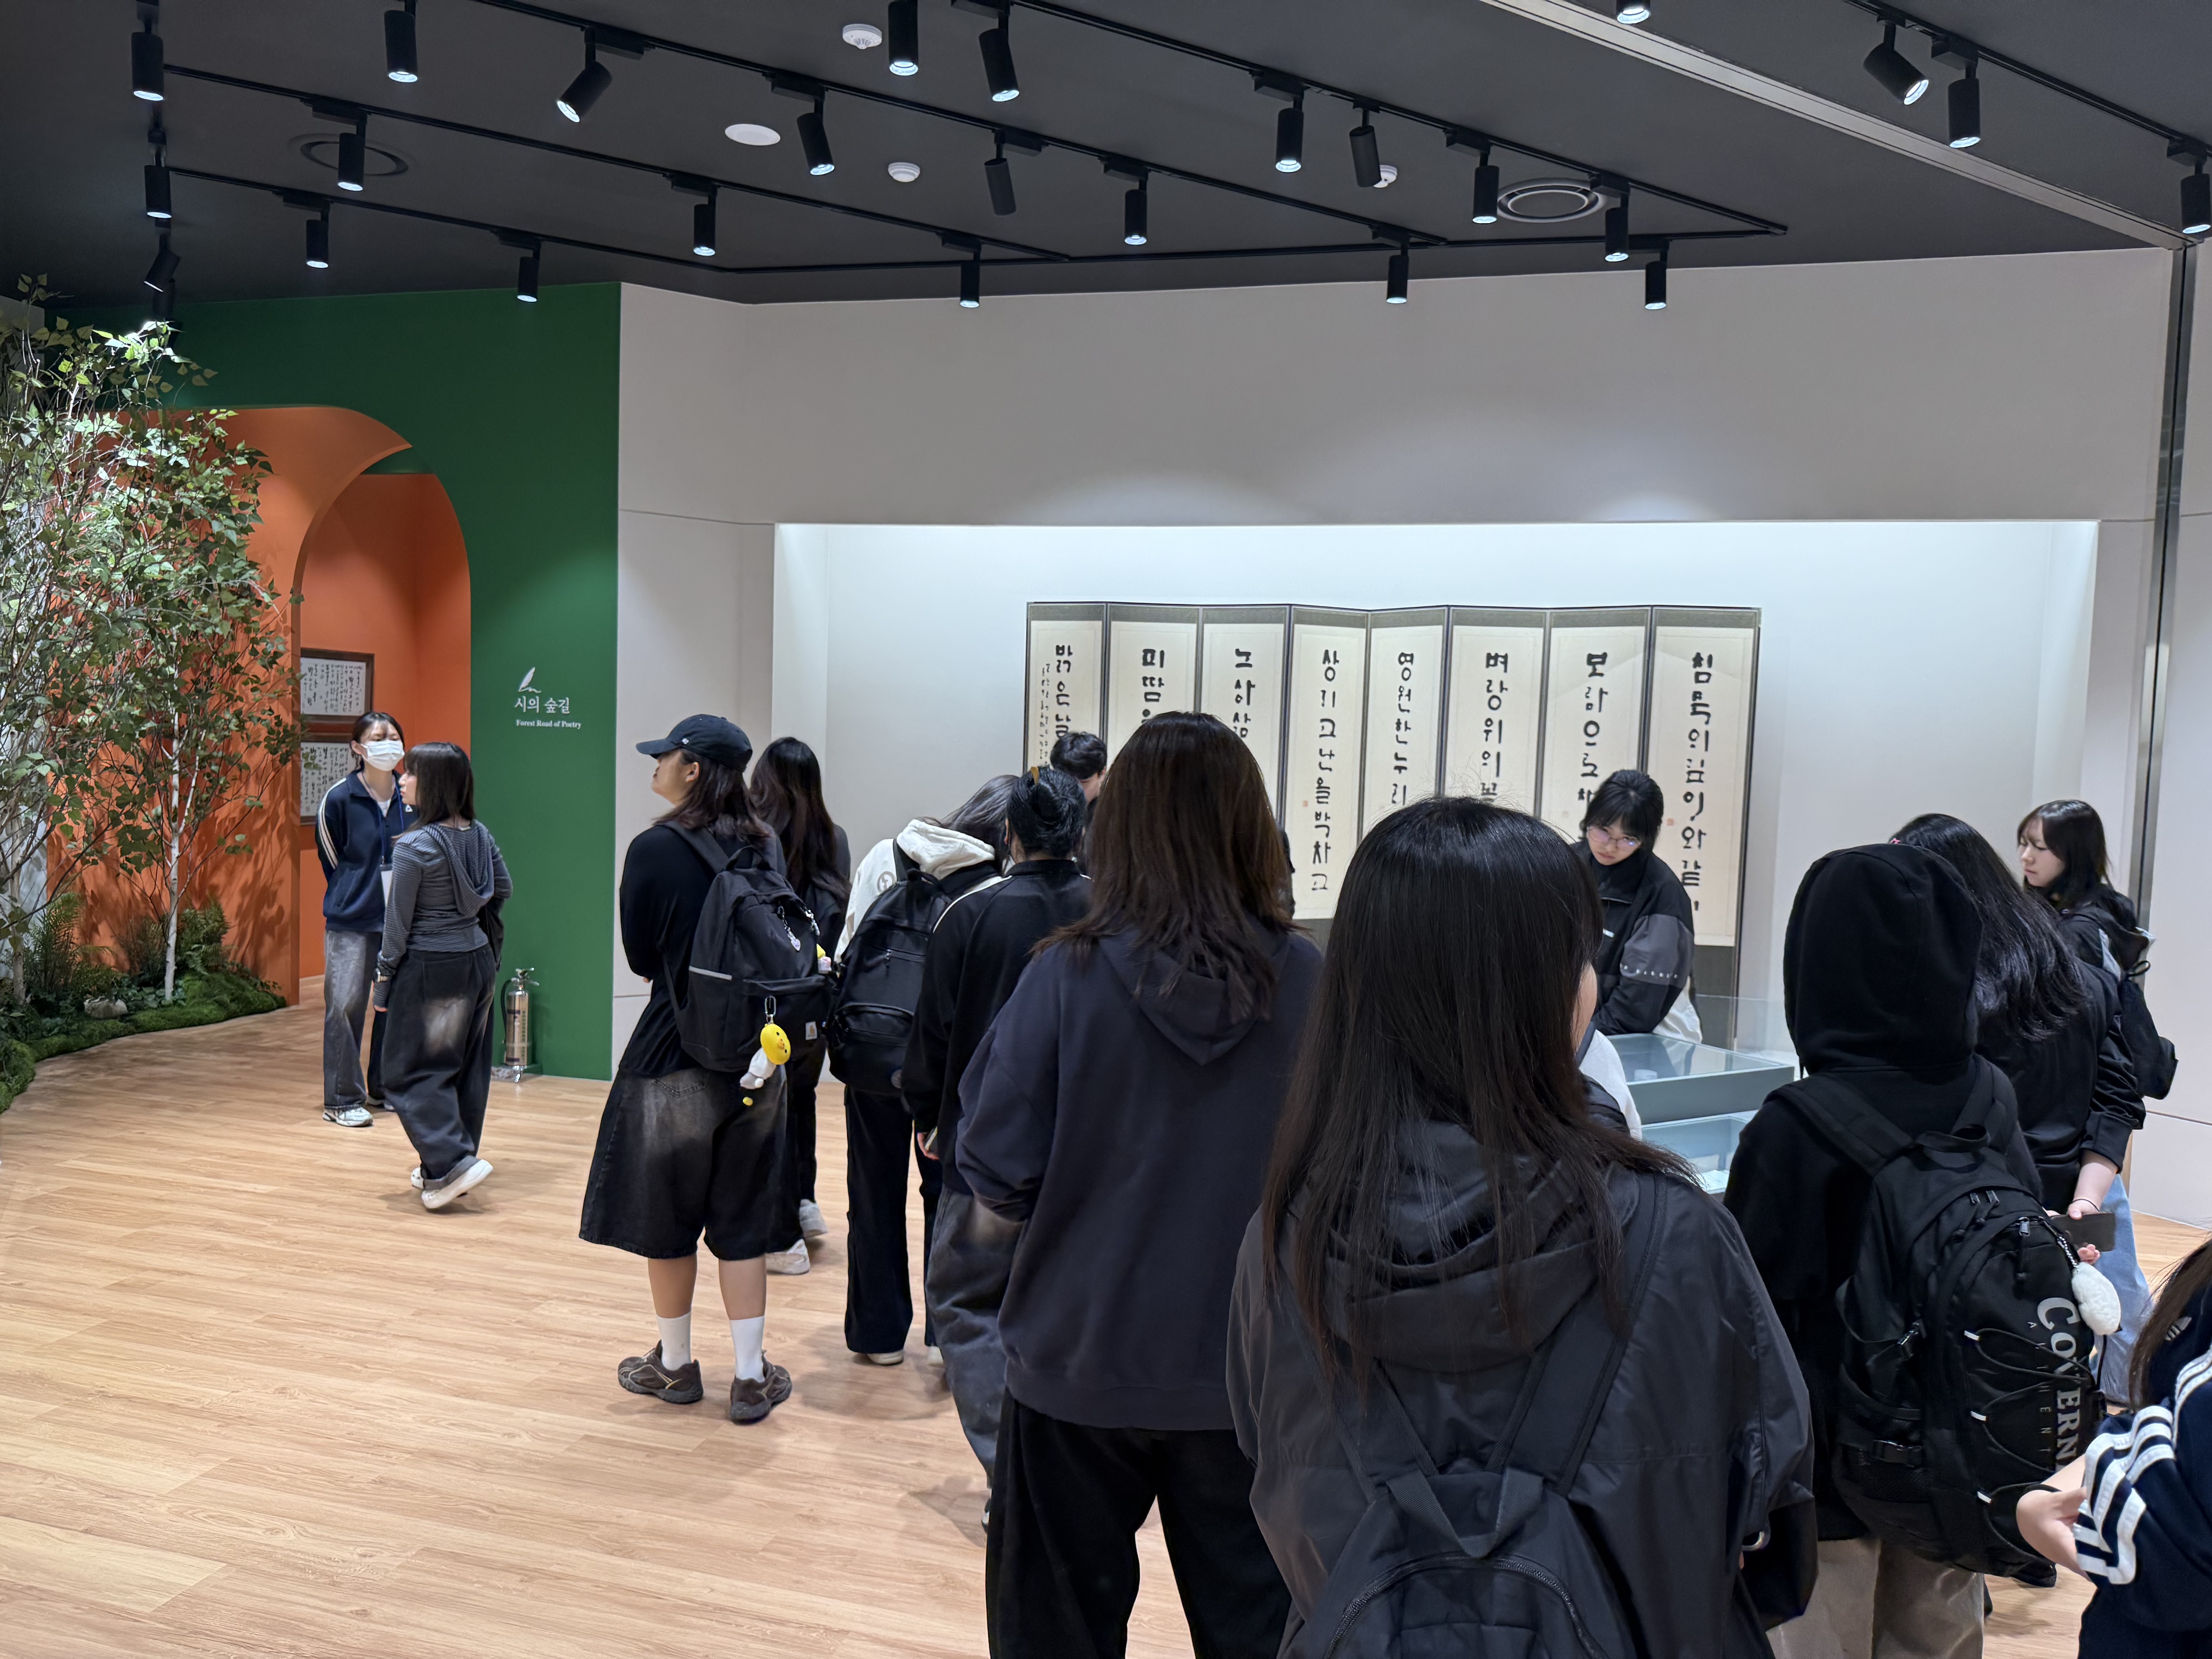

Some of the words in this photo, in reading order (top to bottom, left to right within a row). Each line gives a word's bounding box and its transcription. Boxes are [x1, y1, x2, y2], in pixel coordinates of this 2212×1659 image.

[514, 696, 539, 713] 시의
[544, 697, 570, 714] 숲길
[562, 721, 582, 730] Poetry
[2037, 1297, 2081, 1472] COVERN
